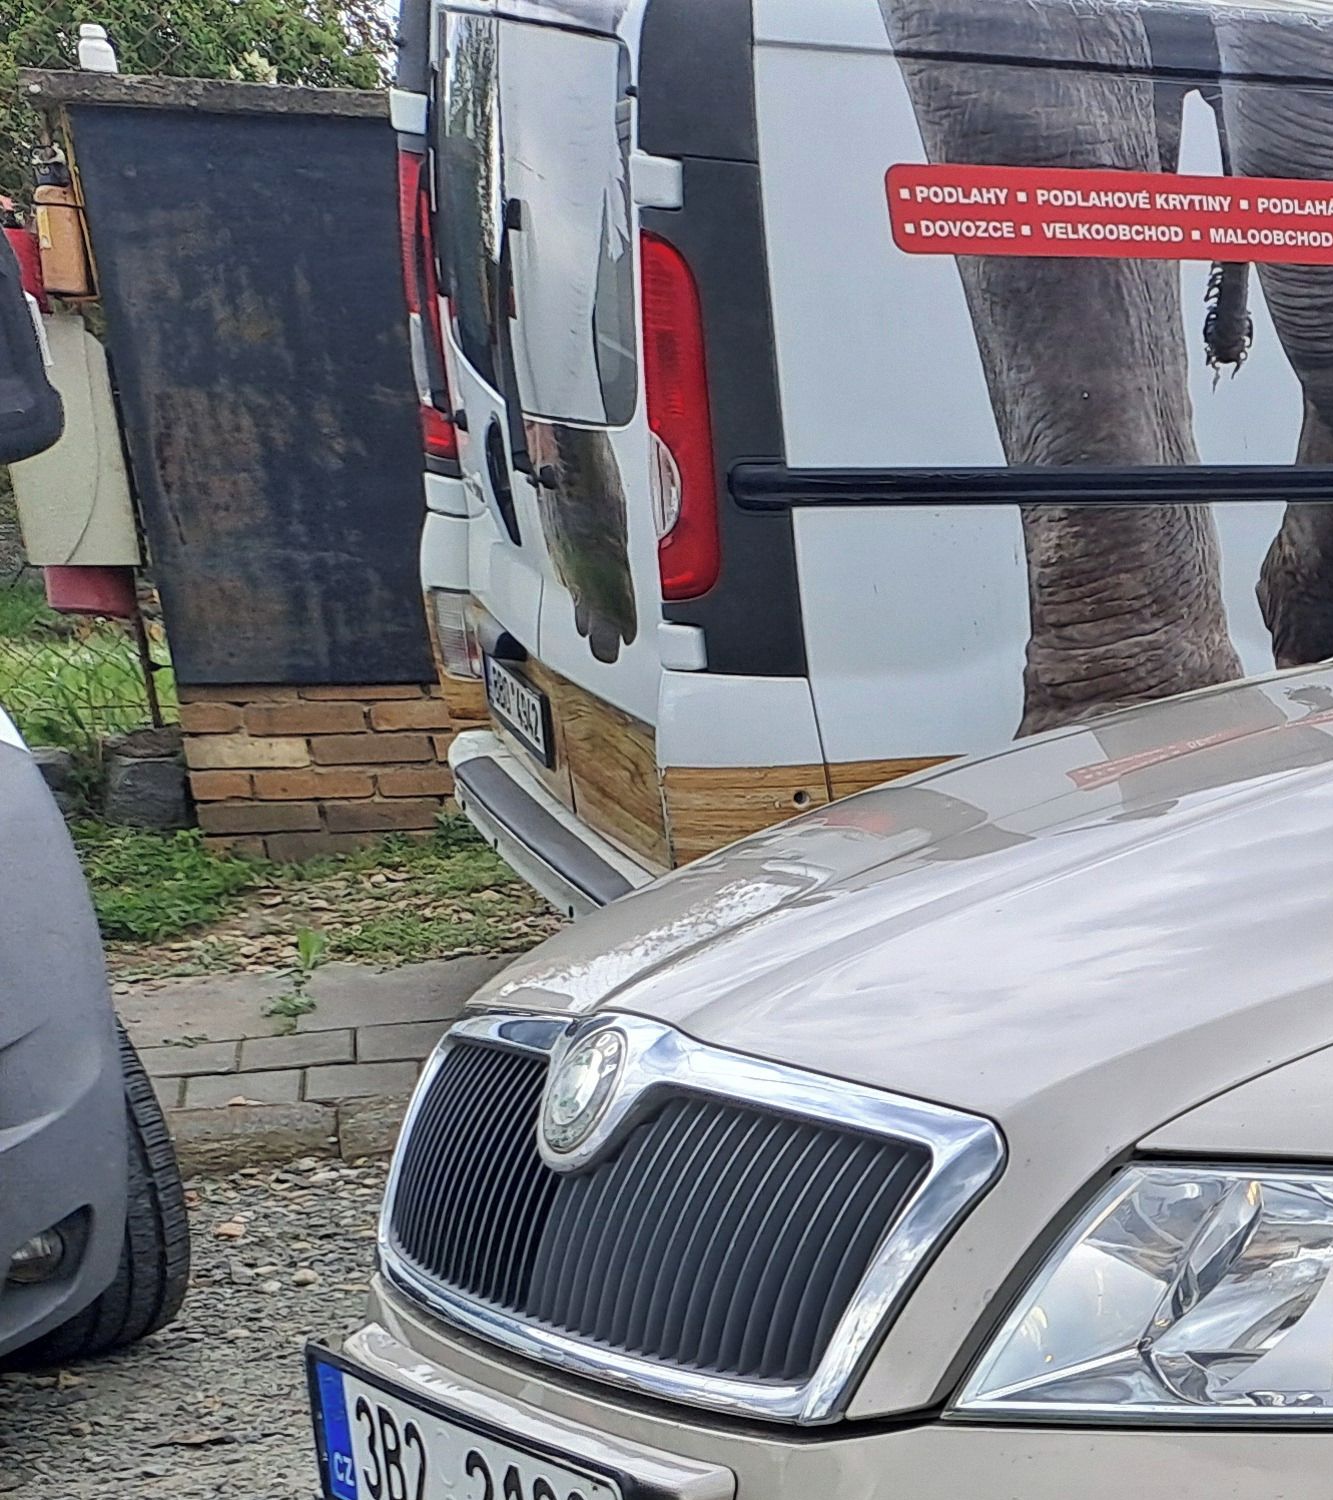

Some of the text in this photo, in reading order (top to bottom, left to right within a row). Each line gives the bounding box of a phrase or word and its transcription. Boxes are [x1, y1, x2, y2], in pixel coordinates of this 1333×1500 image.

[914, 186, 1008, 205] PODLAHY
[1036, 189, 1151, 209] PODLAHOVÉ
[1155, 193, 1232, 213] KRYTINY
[920, 220, 1016, 239] DOVOZCE
[1042, 222, 1184, 243] VELKOOBCHOD
[1209, 227, 1333, 247] MALOOBCHOD
[333, 1451, 356, 1487] CZ
